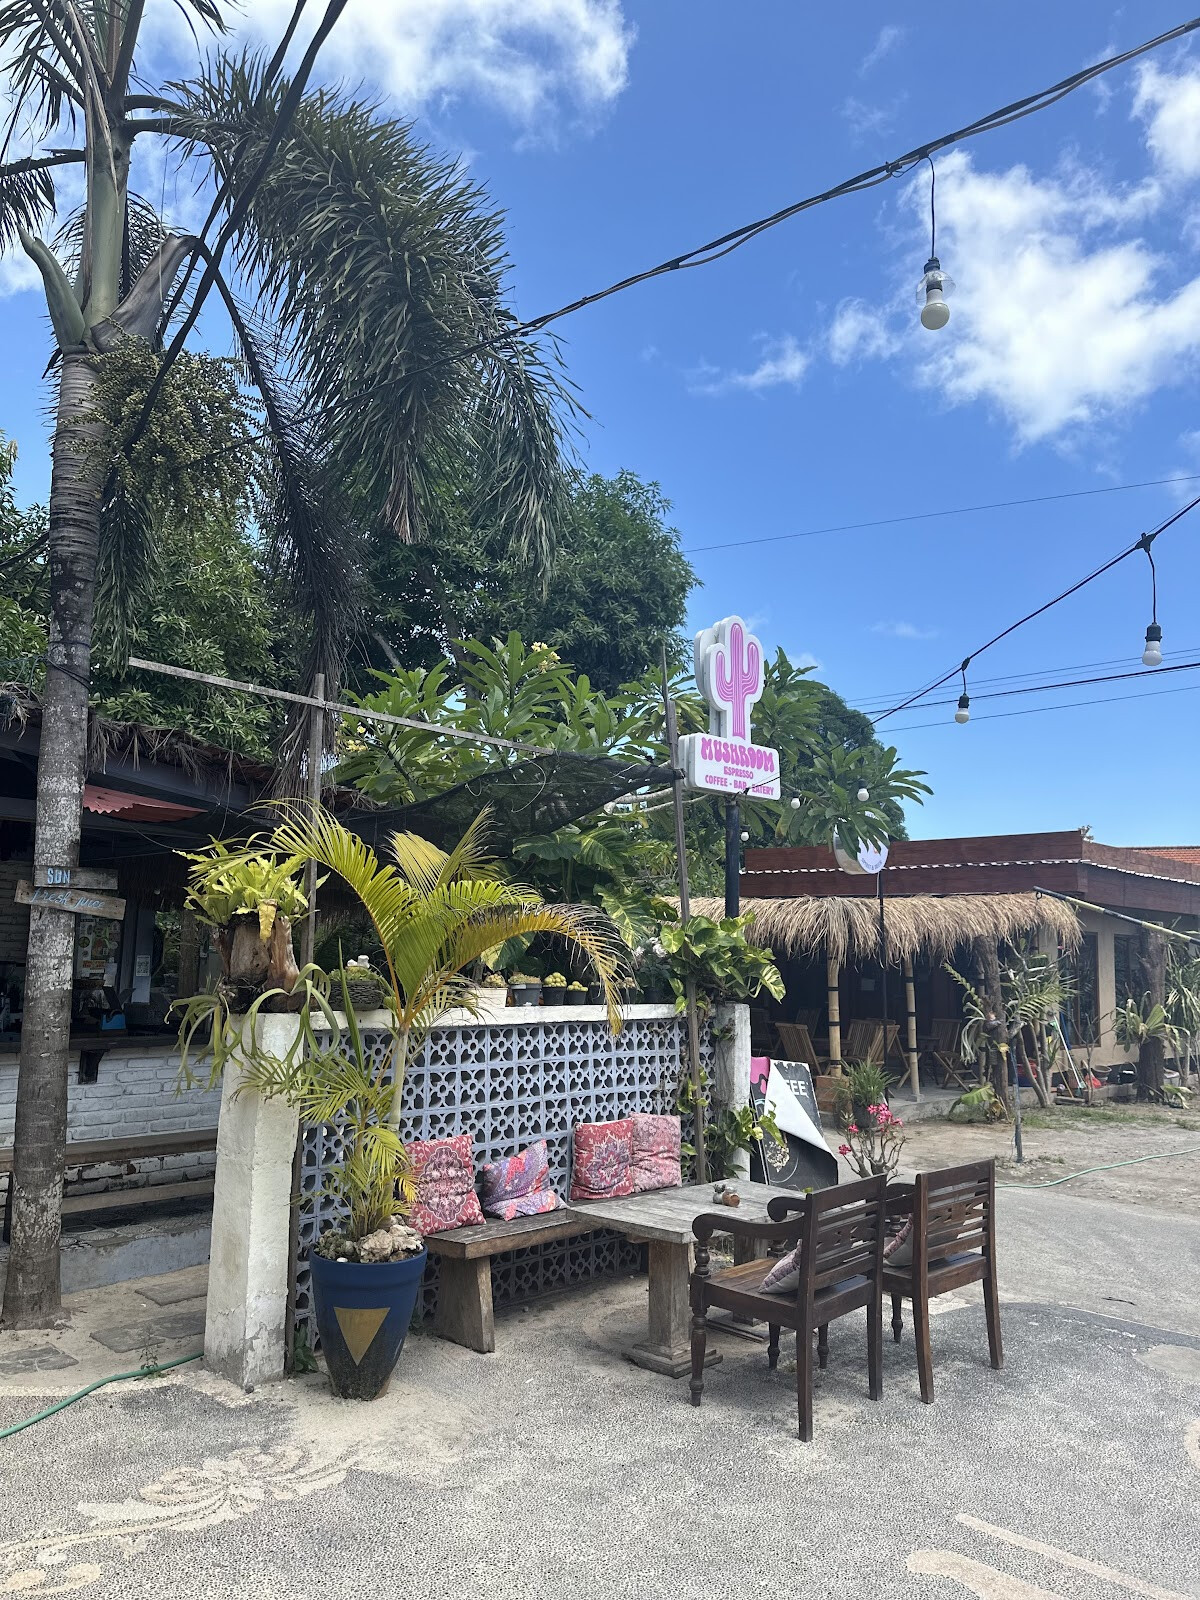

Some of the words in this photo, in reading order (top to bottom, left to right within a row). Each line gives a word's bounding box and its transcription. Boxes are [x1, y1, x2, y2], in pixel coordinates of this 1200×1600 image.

[701, 737, 775, 773] MUSHROOM
[723, 766, 754, 780] ESPRESSO
[704, 775, 728, 787] COFFEE
[752, 784, 774, 796] EATERY
[29, 887, 72, 906] fresh
[68, 896, 106, 910] juice
